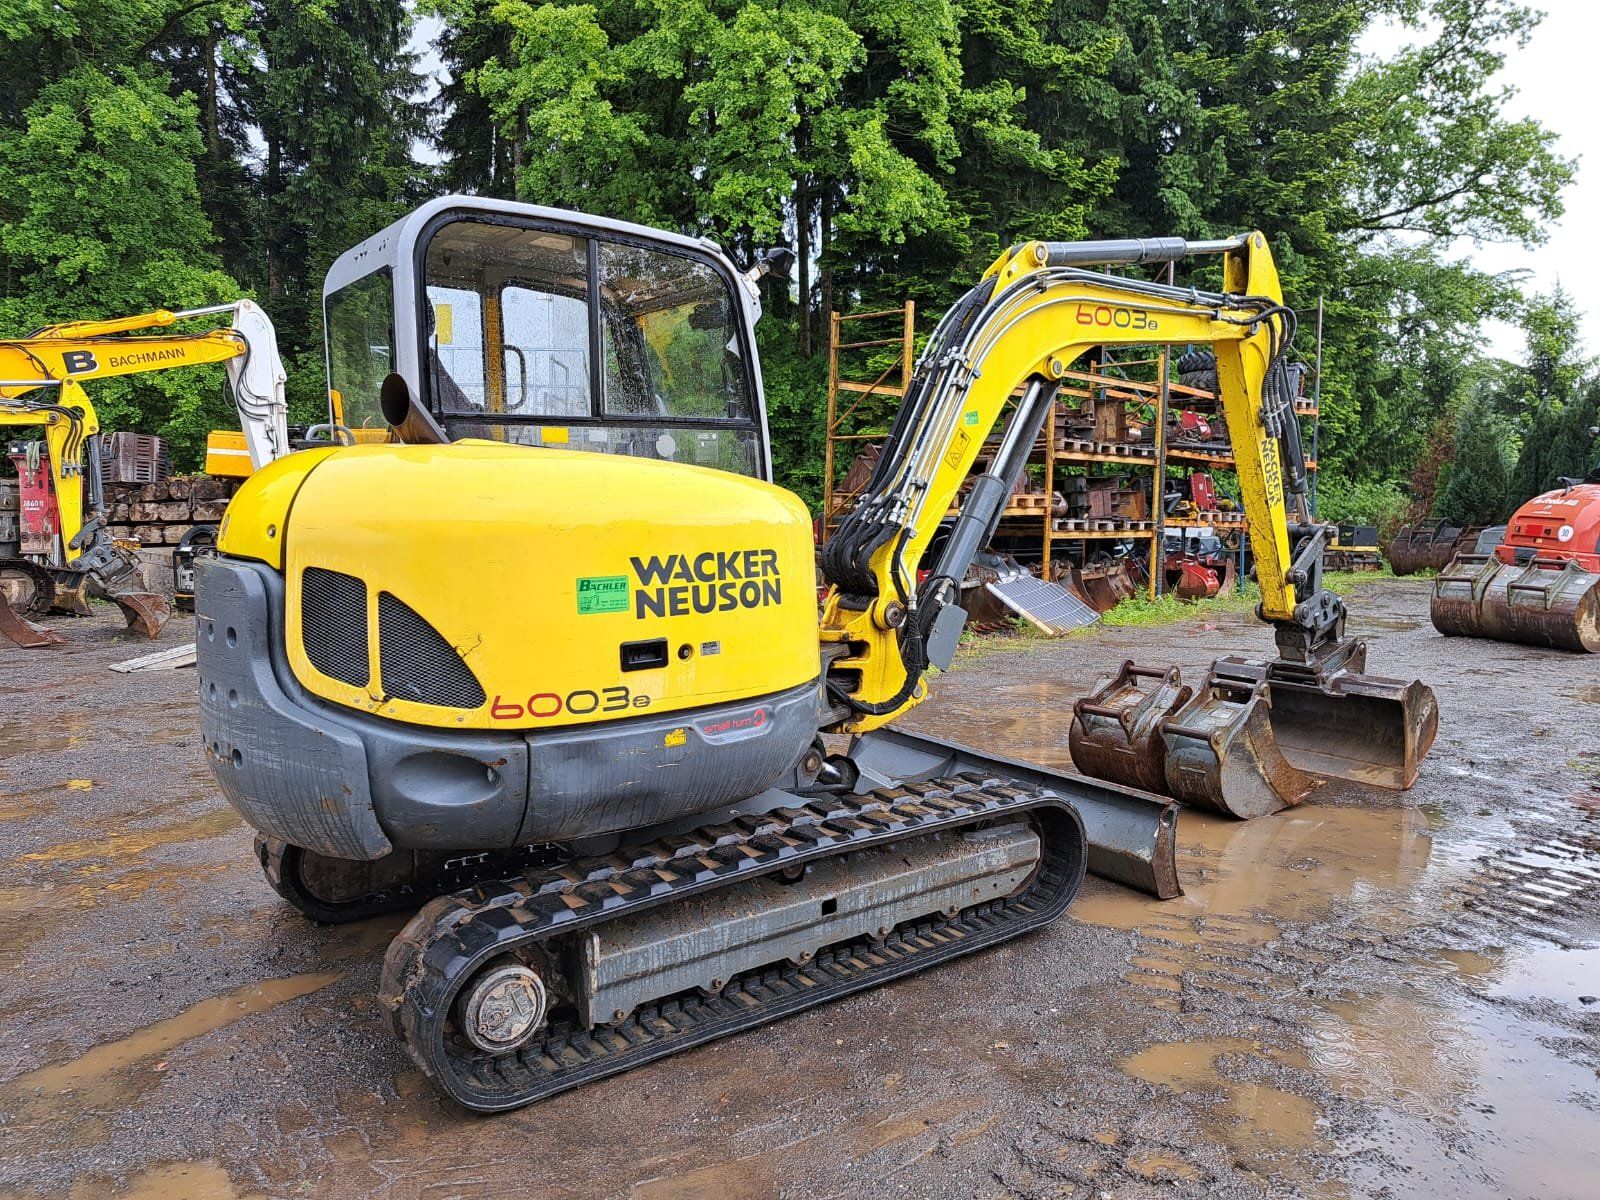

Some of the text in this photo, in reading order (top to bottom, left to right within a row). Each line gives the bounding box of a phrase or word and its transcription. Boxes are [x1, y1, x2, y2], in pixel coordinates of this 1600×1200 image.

[62, 348, 186, 375] B BACHMANN
[1268, 438, 1281, 507] WACKER
[630, 549, 780, 586] WACKER
[635, 578, 782, 620] NEUSON
